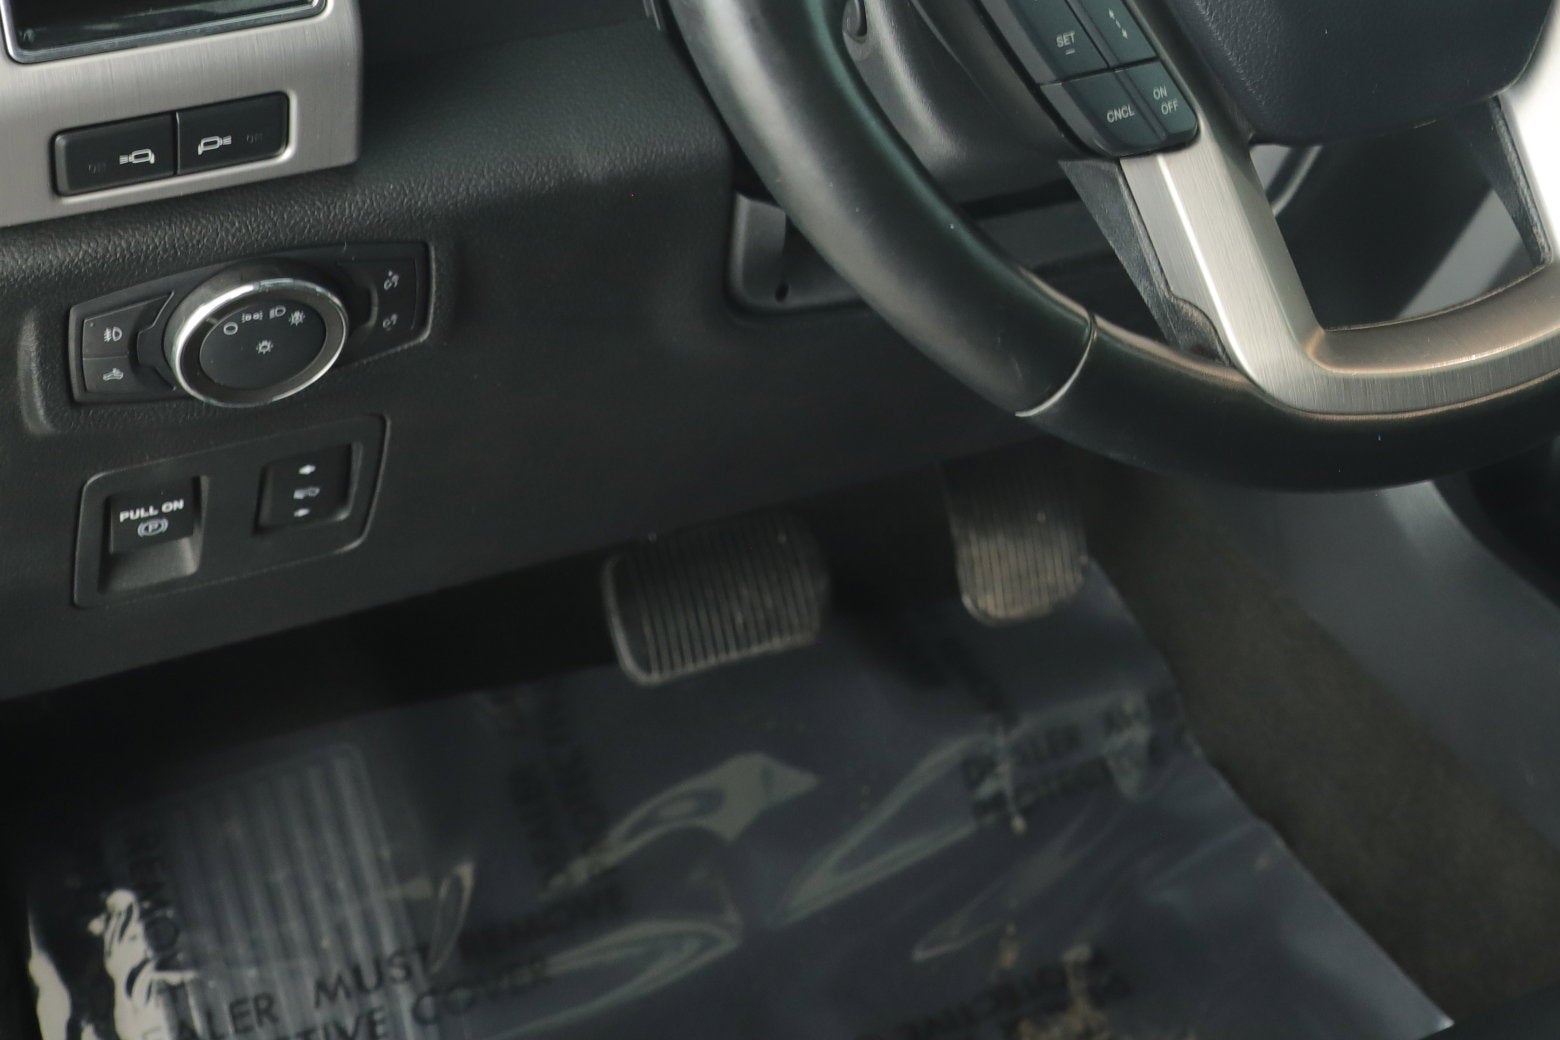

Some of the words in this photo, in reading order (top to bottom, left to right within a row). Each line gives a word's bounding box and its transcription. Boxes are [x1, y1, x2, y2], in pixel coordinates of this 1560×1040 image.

[1056, 31, 1076, 49] SET
[1152, 86, 1168, 102] ON
[1106, 103, 1136, 124] CNCL
[1160, 100, 1180, 116] OFF
[119, 505, 159, 523] PULL
[161, 498, 184, 514] ON
